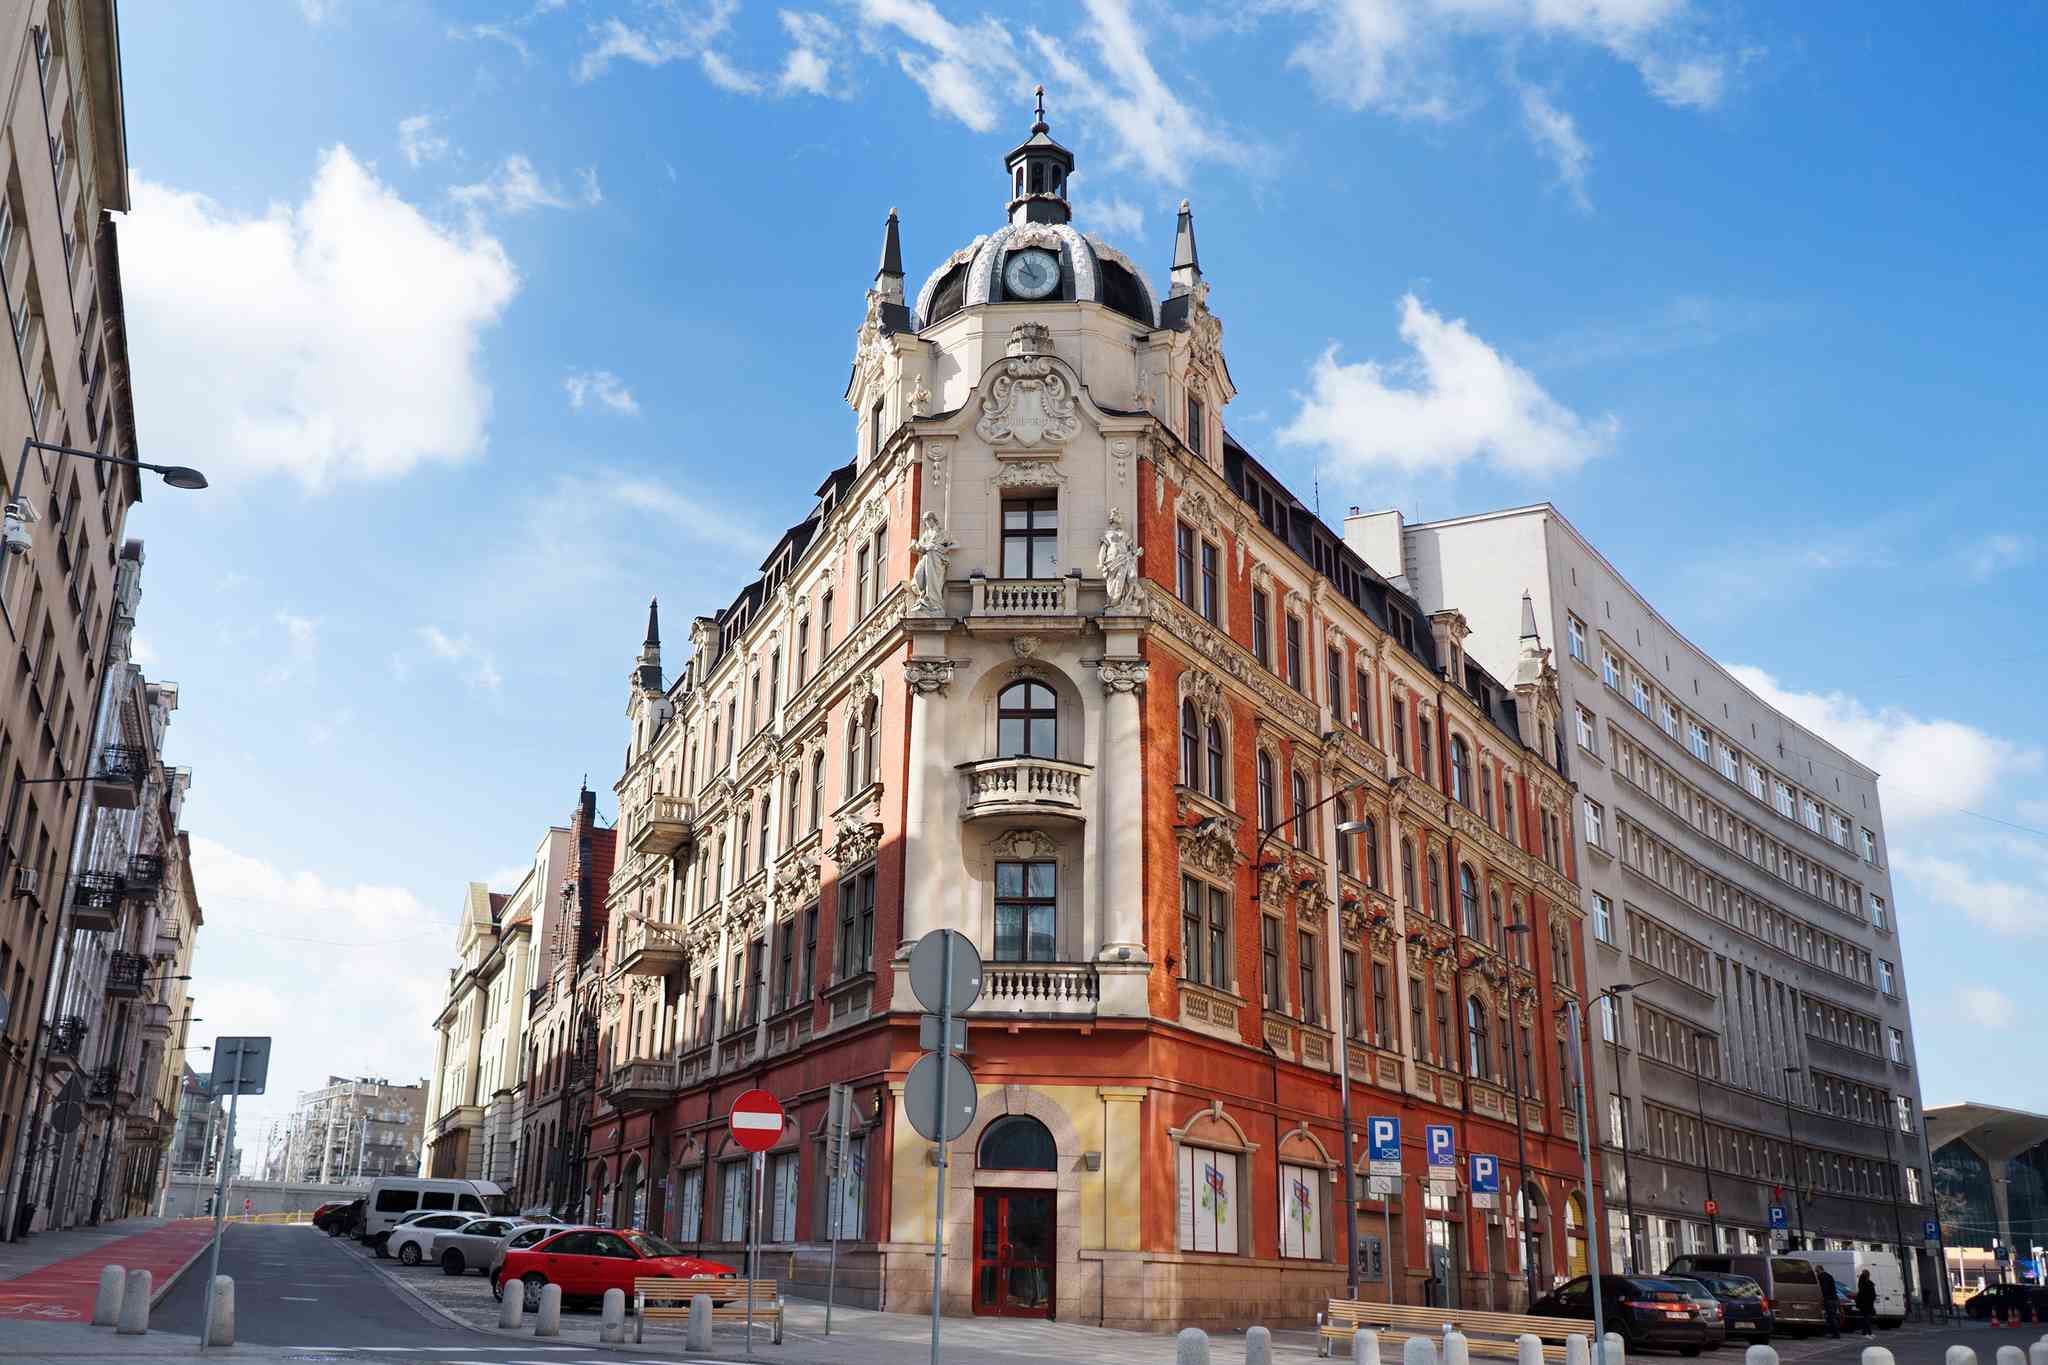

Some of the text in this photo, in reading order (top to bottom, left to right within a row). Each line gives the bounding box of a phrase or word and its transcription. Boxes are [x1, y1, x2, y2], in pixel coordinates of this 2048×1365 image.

[1375, 1121, 1393, 1148] P
[1432, 1129, 1449, 1154] P
[1475, 1158, 1493, 1182] P
[1772, 1208, 1782, 1222] P
